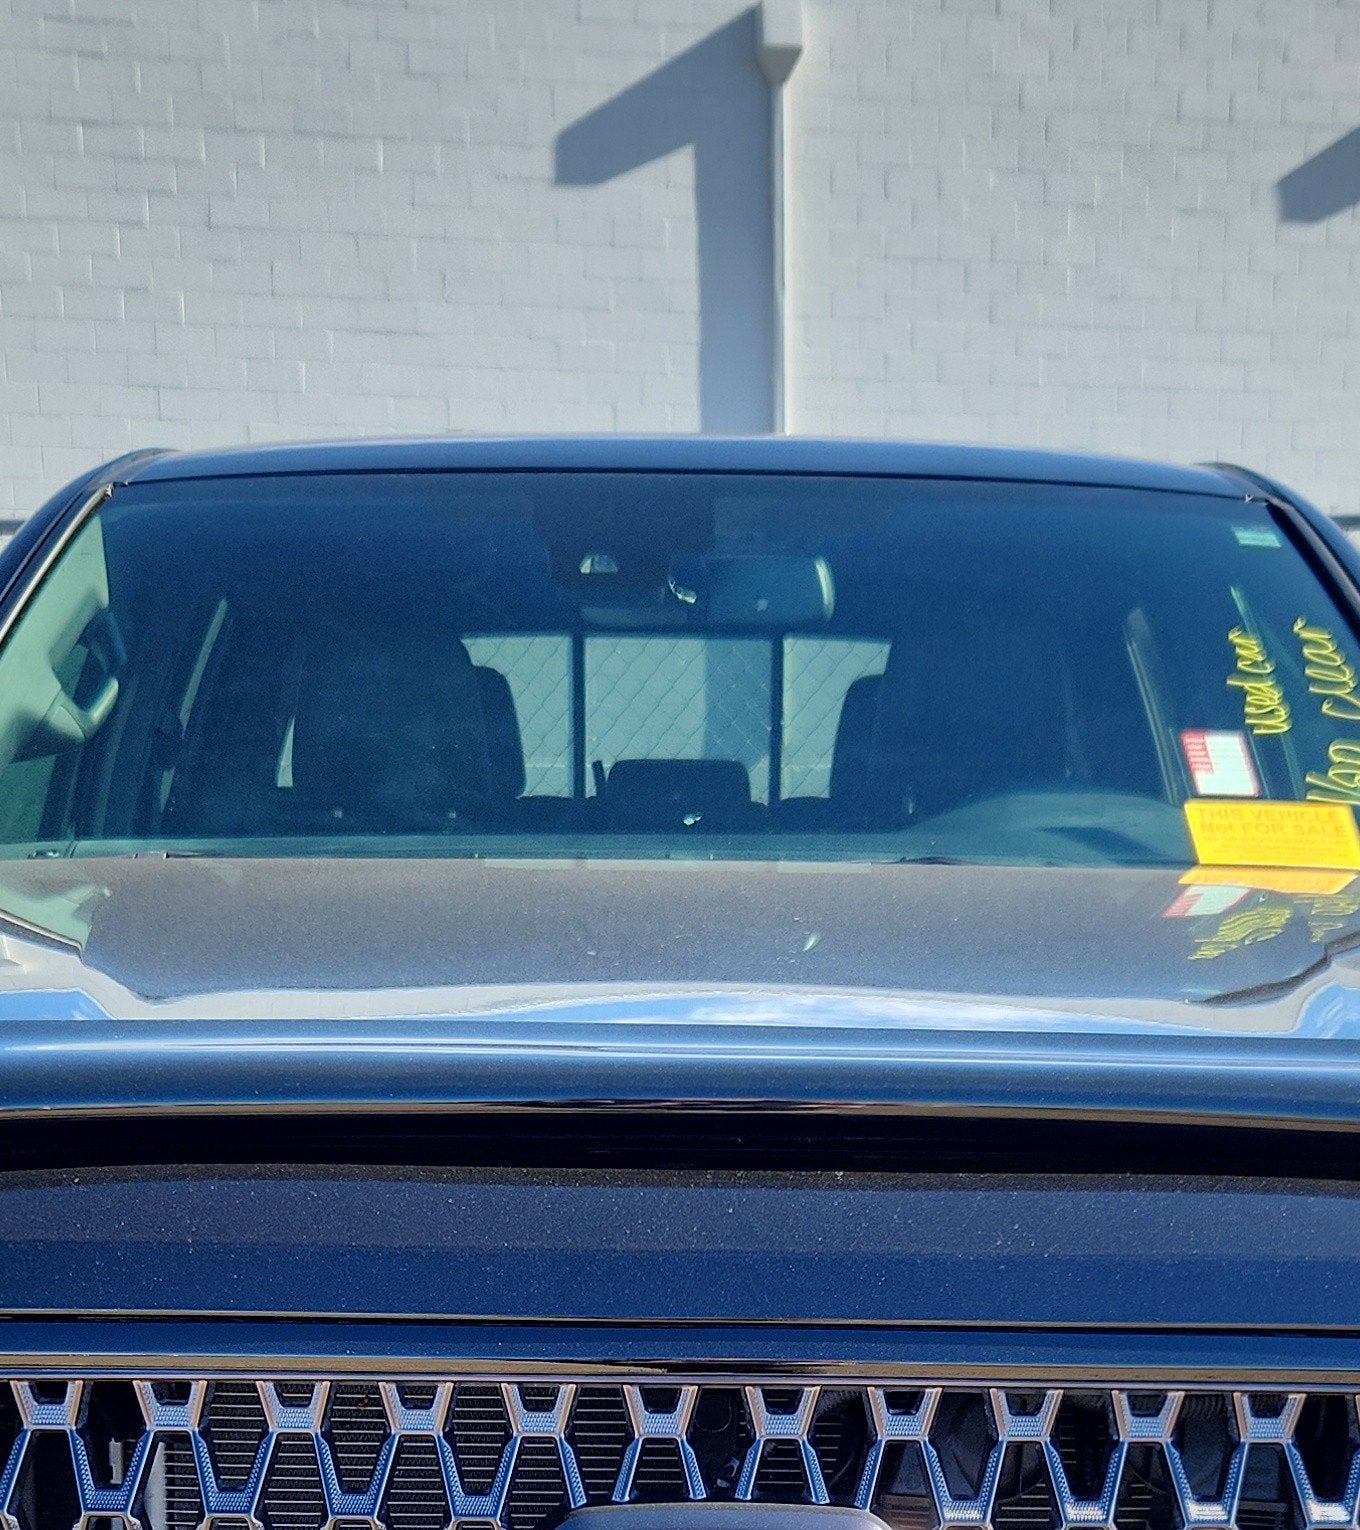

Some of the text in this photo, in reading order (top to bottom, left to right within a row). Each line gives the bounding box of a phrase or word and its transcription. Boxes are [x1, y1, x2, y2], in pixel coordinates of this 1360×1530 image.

[1199, 809, 1341, 824] THIS VEHICLE
[1242, 822, 1284, 836] FOR
[1293, 823, 1348, 838] SALE
